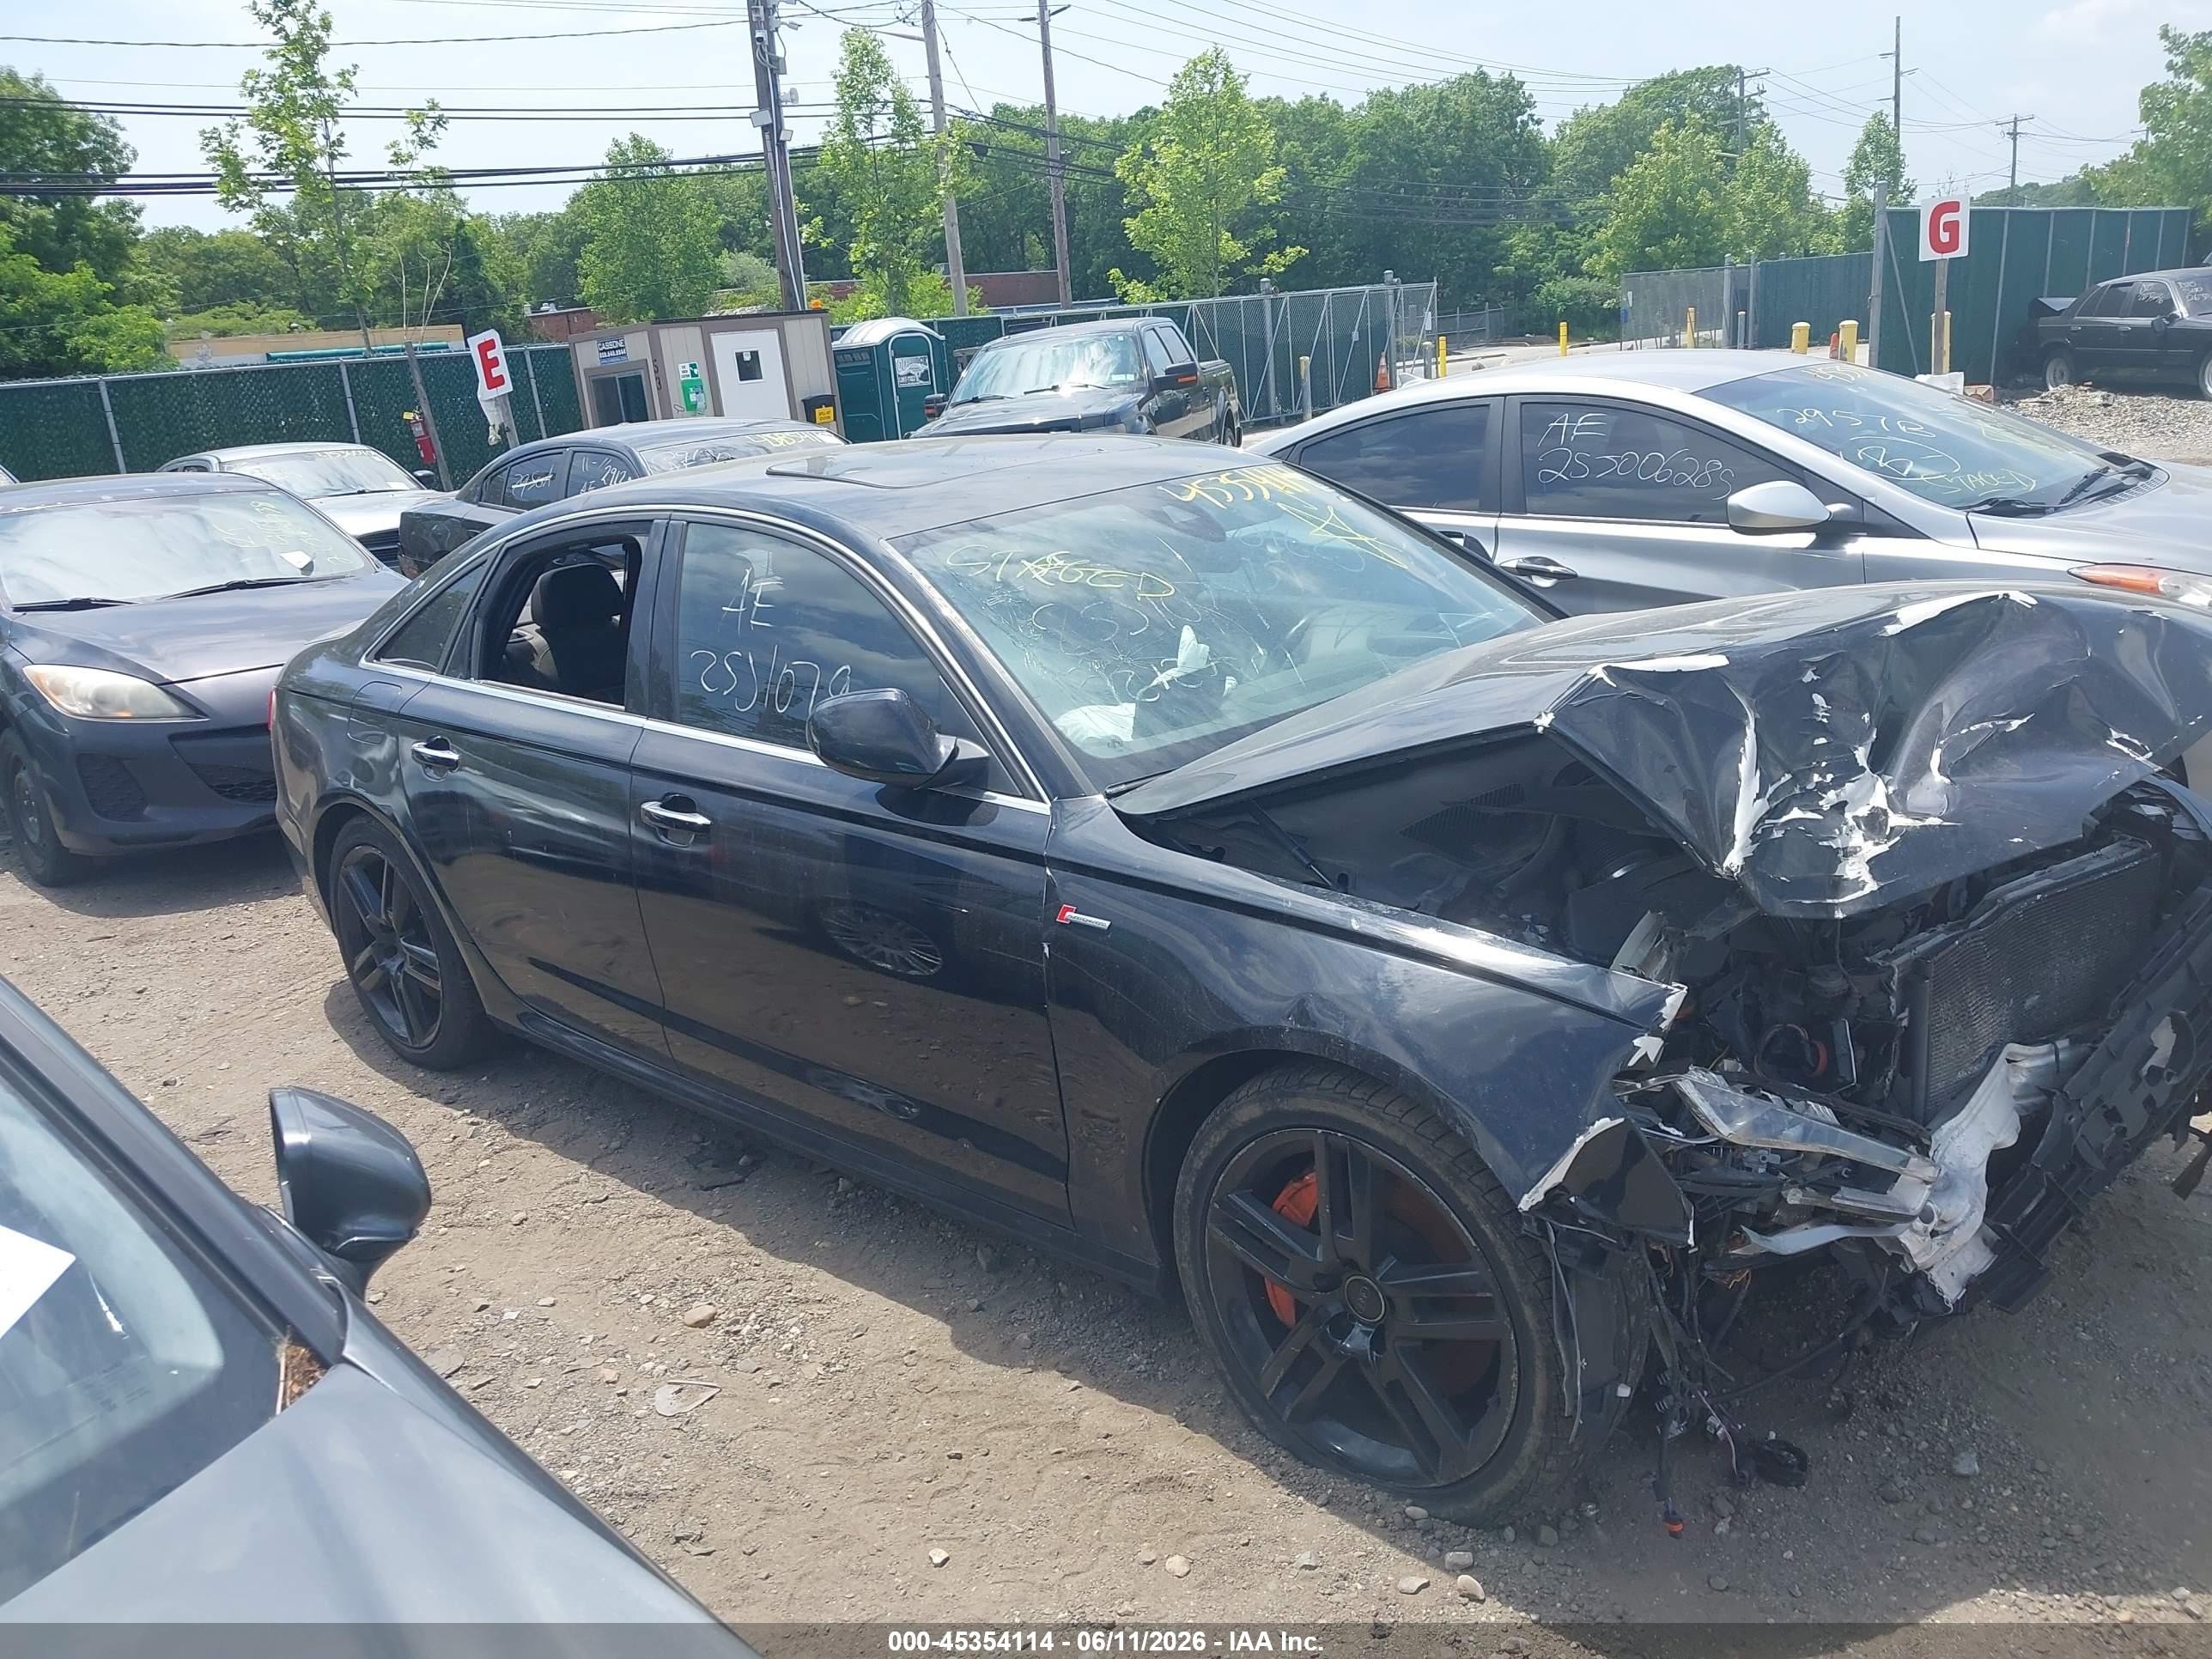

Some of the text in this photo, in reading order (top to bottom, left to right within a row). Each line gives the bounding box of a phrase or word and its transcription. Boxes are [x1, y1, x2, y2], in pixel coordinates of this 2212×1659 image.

[1929, 200, 1960, 254] G
[477, 338, 505, 391] E
[598, 338, 626, 351] CASSONE
[1538, 413, 1608, 447] AE
[717, 567, 785, 638] AE
